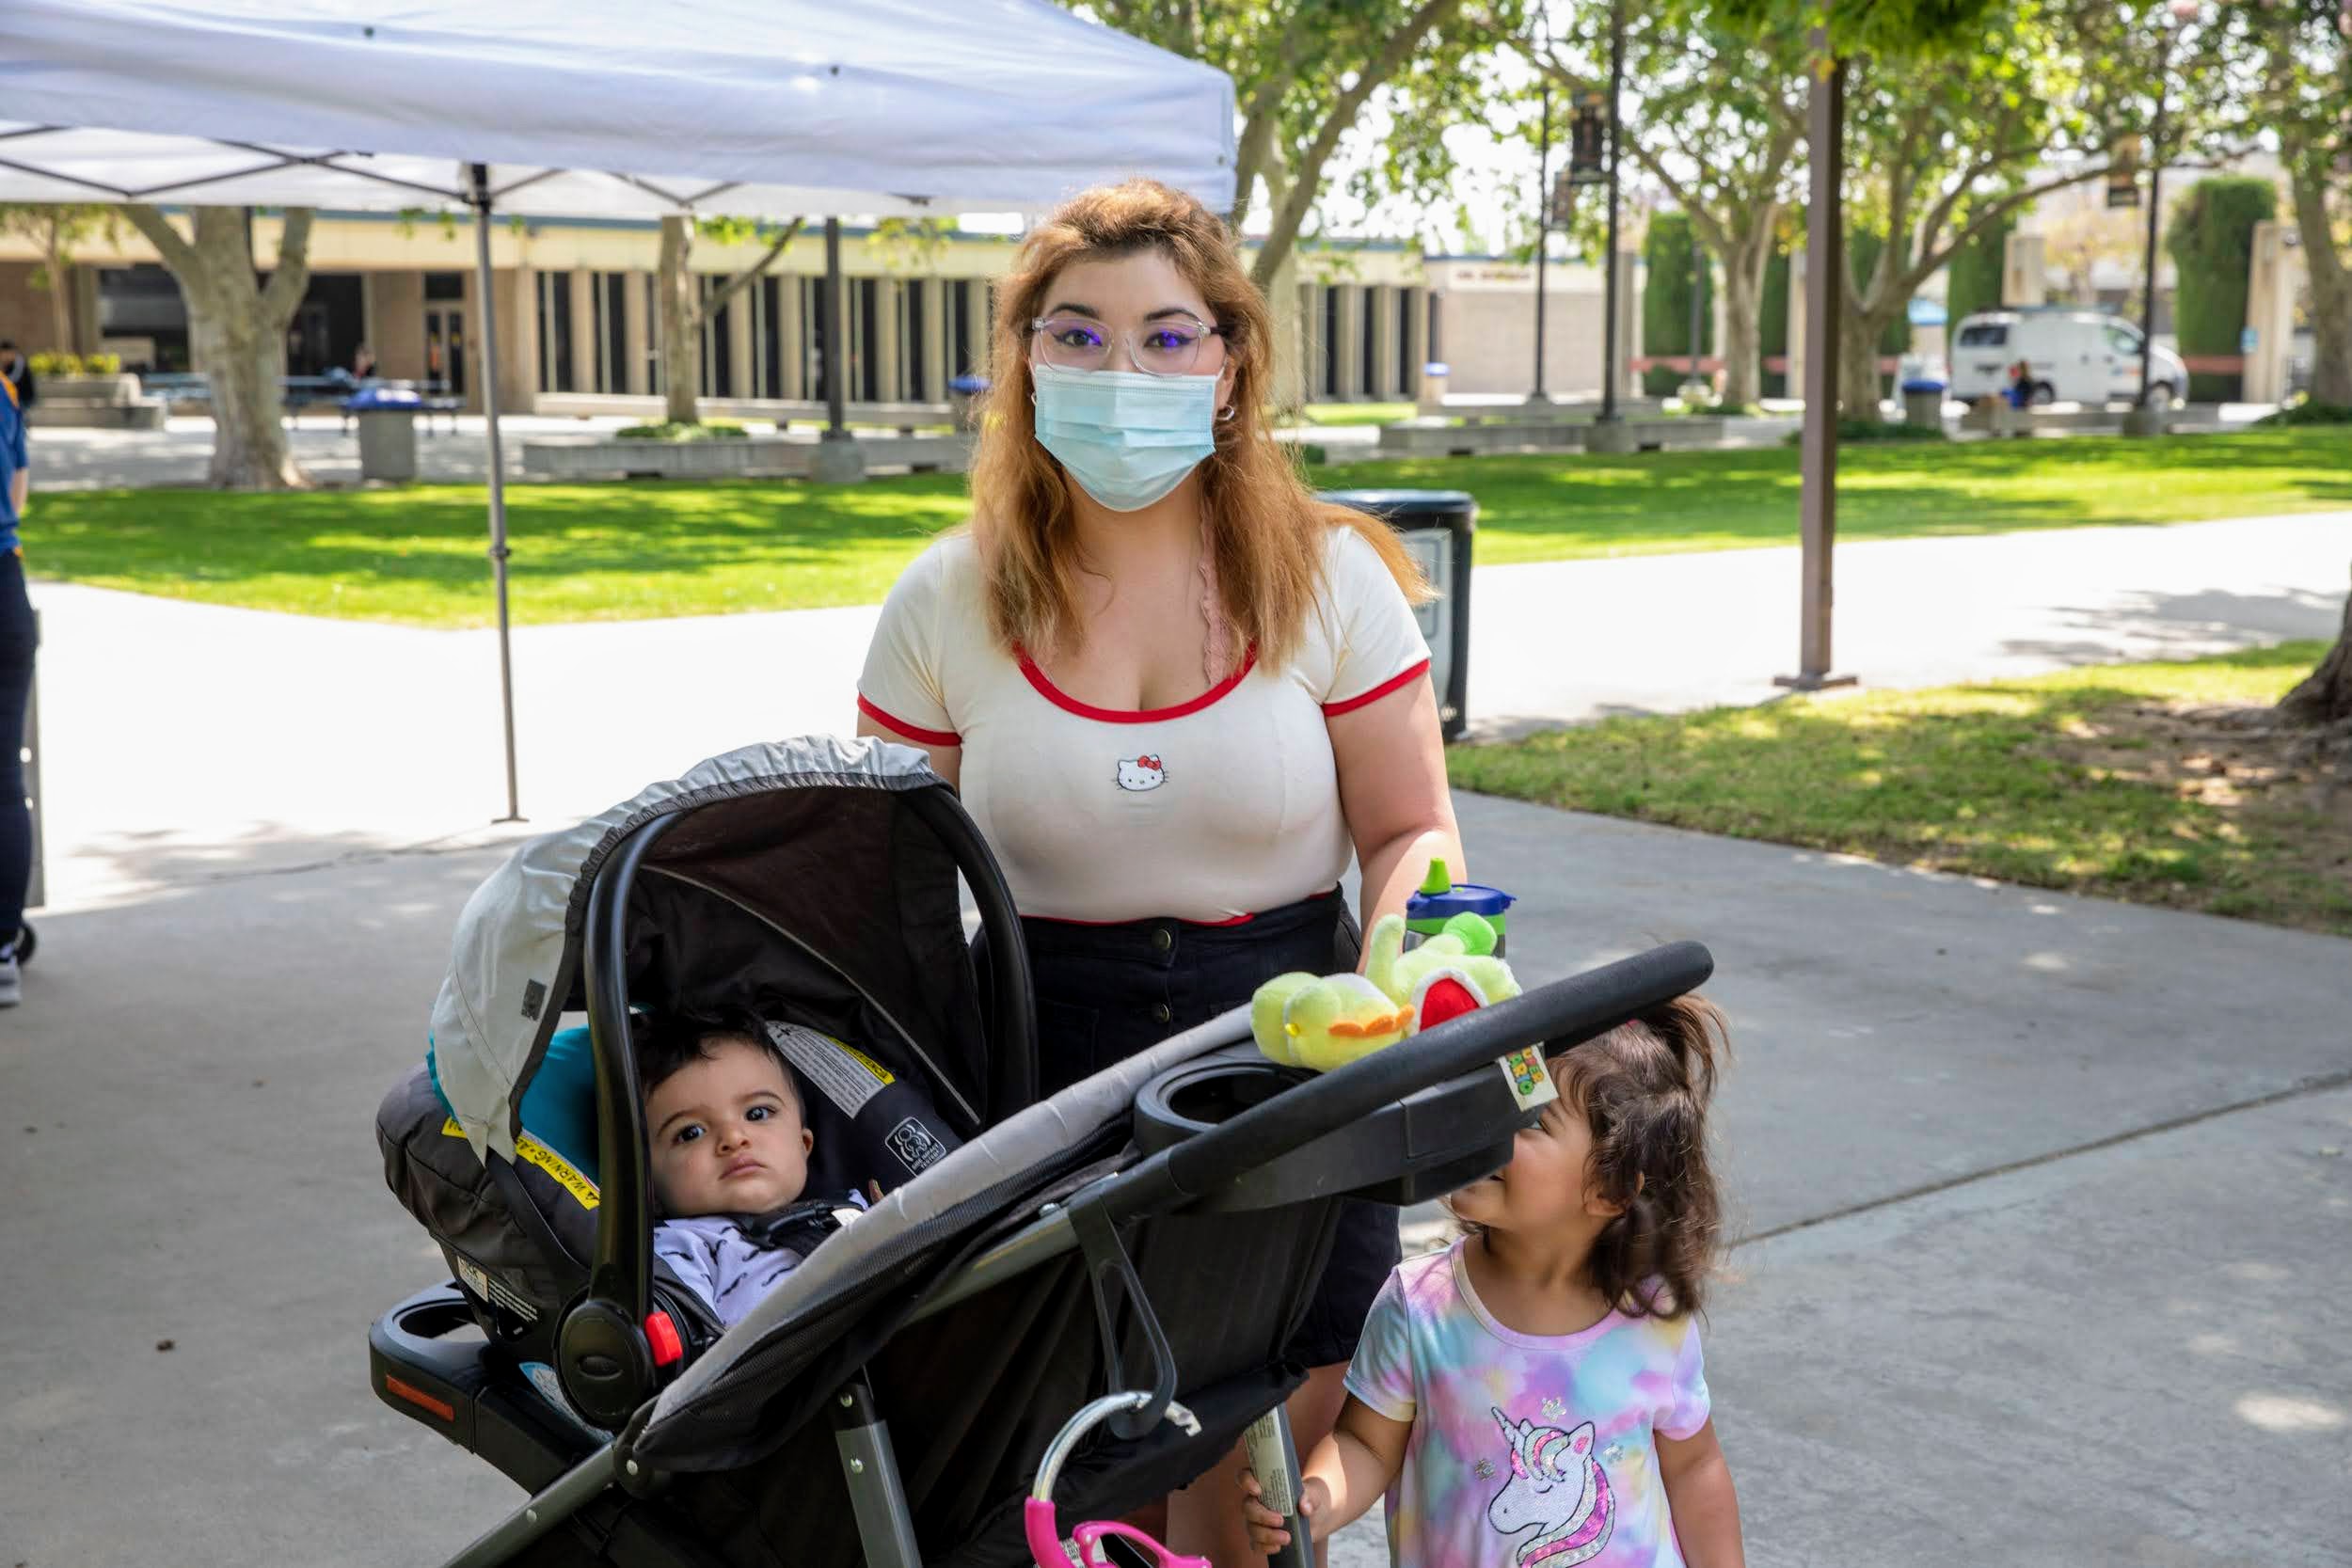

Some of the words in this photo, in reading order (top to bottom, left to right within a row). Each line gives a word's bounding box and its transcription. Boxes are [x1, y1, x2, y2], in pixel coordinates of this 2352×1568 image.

[1521, 1047, 1545, 1084] UPER
[921, 1142, 940, 1161] IMPACT
[534, 1149, 587, 1196] WARNING
